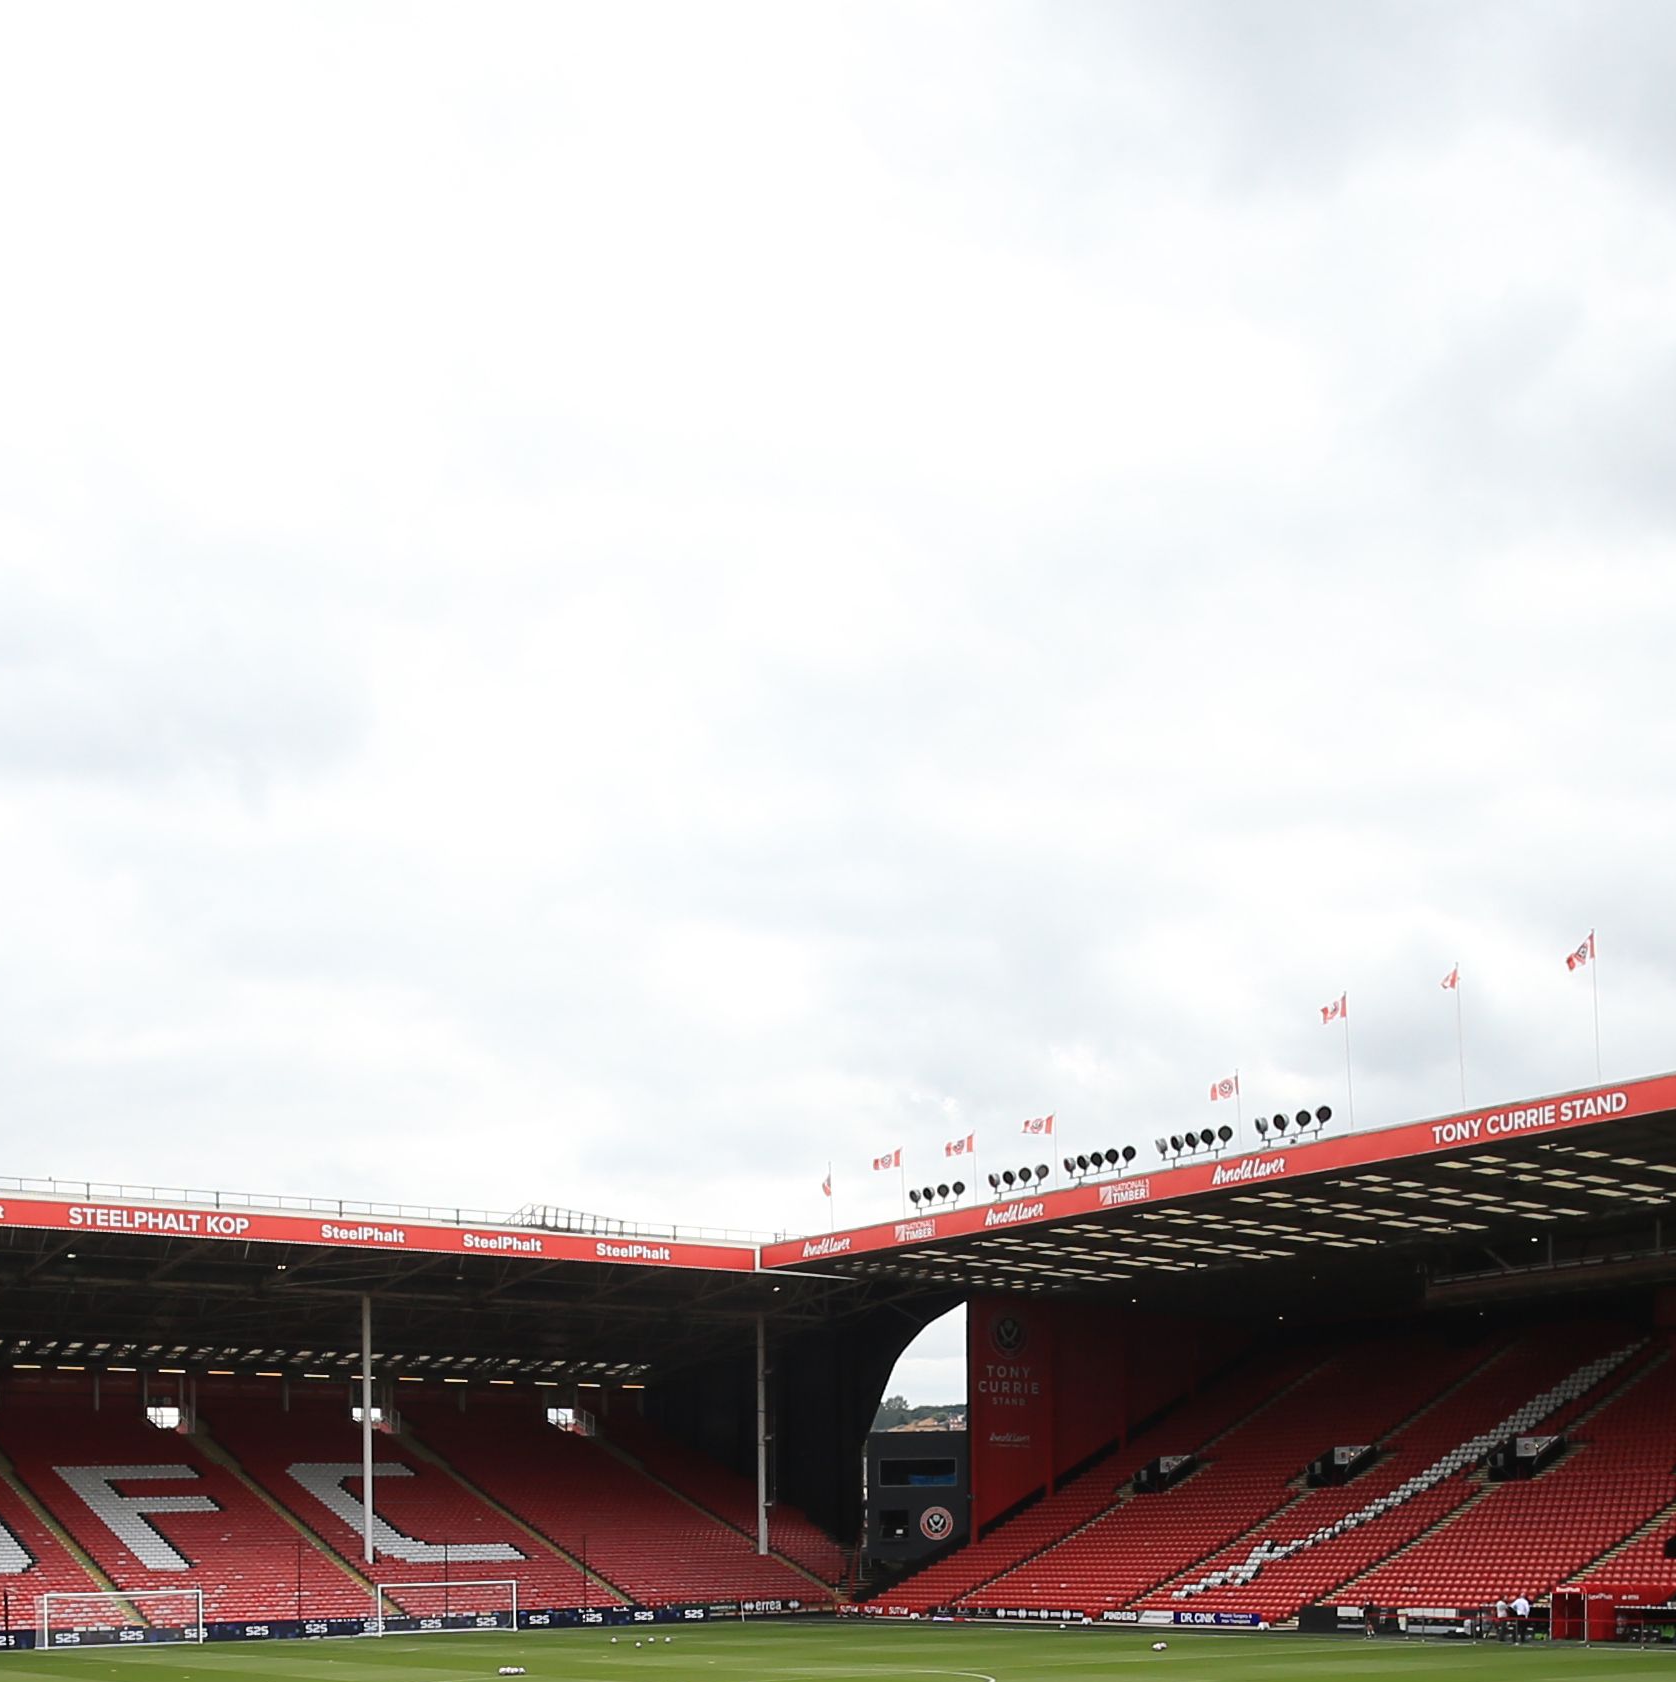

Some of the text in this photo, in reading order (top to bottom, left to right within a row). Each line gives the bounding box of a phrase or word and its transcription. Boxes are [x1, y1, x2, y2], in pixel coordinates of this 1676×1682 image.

[1432, 1091, 1628, 1145] TONY CURRIE STAND
[1211, 1158, 1285, 1185] Arnold Laver
[1113, 1179, 1145, 1194] NATIONAL
[1113, 1188, 1147, 1203] TIMBER
[985, 1201, 1045, 1226] Arnold Laver
[69, 1206, 250, 1235] STEELPHALT KOP
[321, 1224, 405, 1244] SteelPhalt
[463, 1233, 543, 1253] SteelPhalt
[596, 1243, 670, 1261] SteelPhalt
[986, 1365, 1030, 1378] TONY
[978, 1381, 1040, 1394] CURRIE
[755, 1600, 782, 1611] errea
[529, 1614, 550, 1625] S2S
[634, 1612, 655, 1621] S2S
[684, 1609, 704, 1619] S2S
[1103, 1611, 1137, 1621] PINDERS
[420, 1619, 442, 1629] S2S
[476, 1617, 497, 1627] S2S
[245, 1626, 269, 1636] S2S
[305, 1623, 328, 1634] S2S
[55, 1633, 81, 1644] S2S
[119, 1631, 145, 1641] S2S
